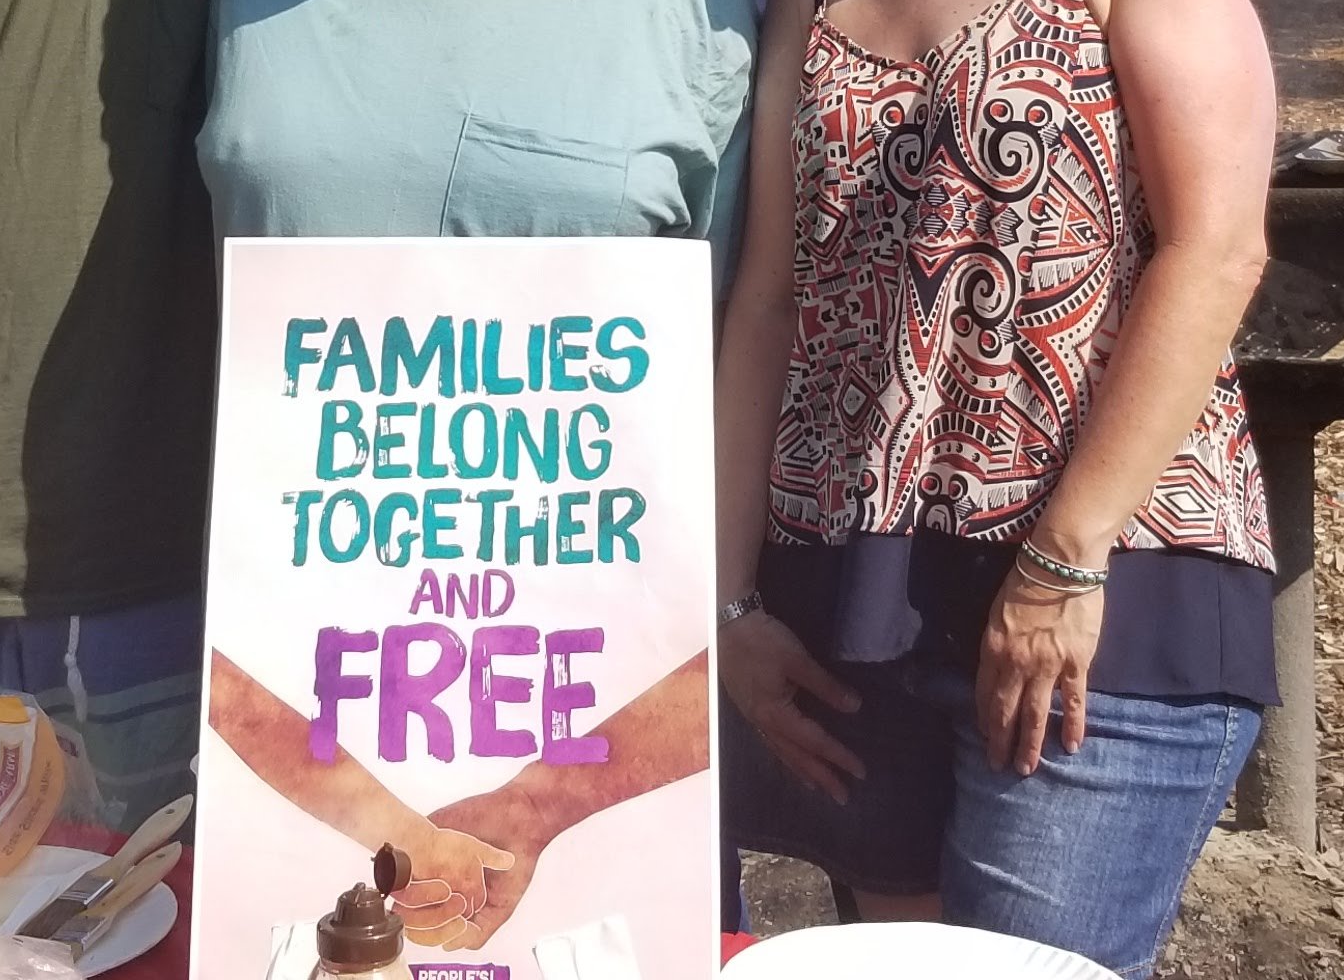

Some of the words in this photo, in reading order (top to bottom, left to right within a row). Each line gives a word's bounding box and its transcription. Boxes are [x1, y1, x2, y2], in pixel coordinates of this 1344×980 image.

[282, 316, 651, 398] FAMILIES
[315, 401, 613, 483] BELONG
[281, 487, 648, 567] TOGETHER
[409, 568, 515, 619] AND
[309, 624, 610, 765] FREE
